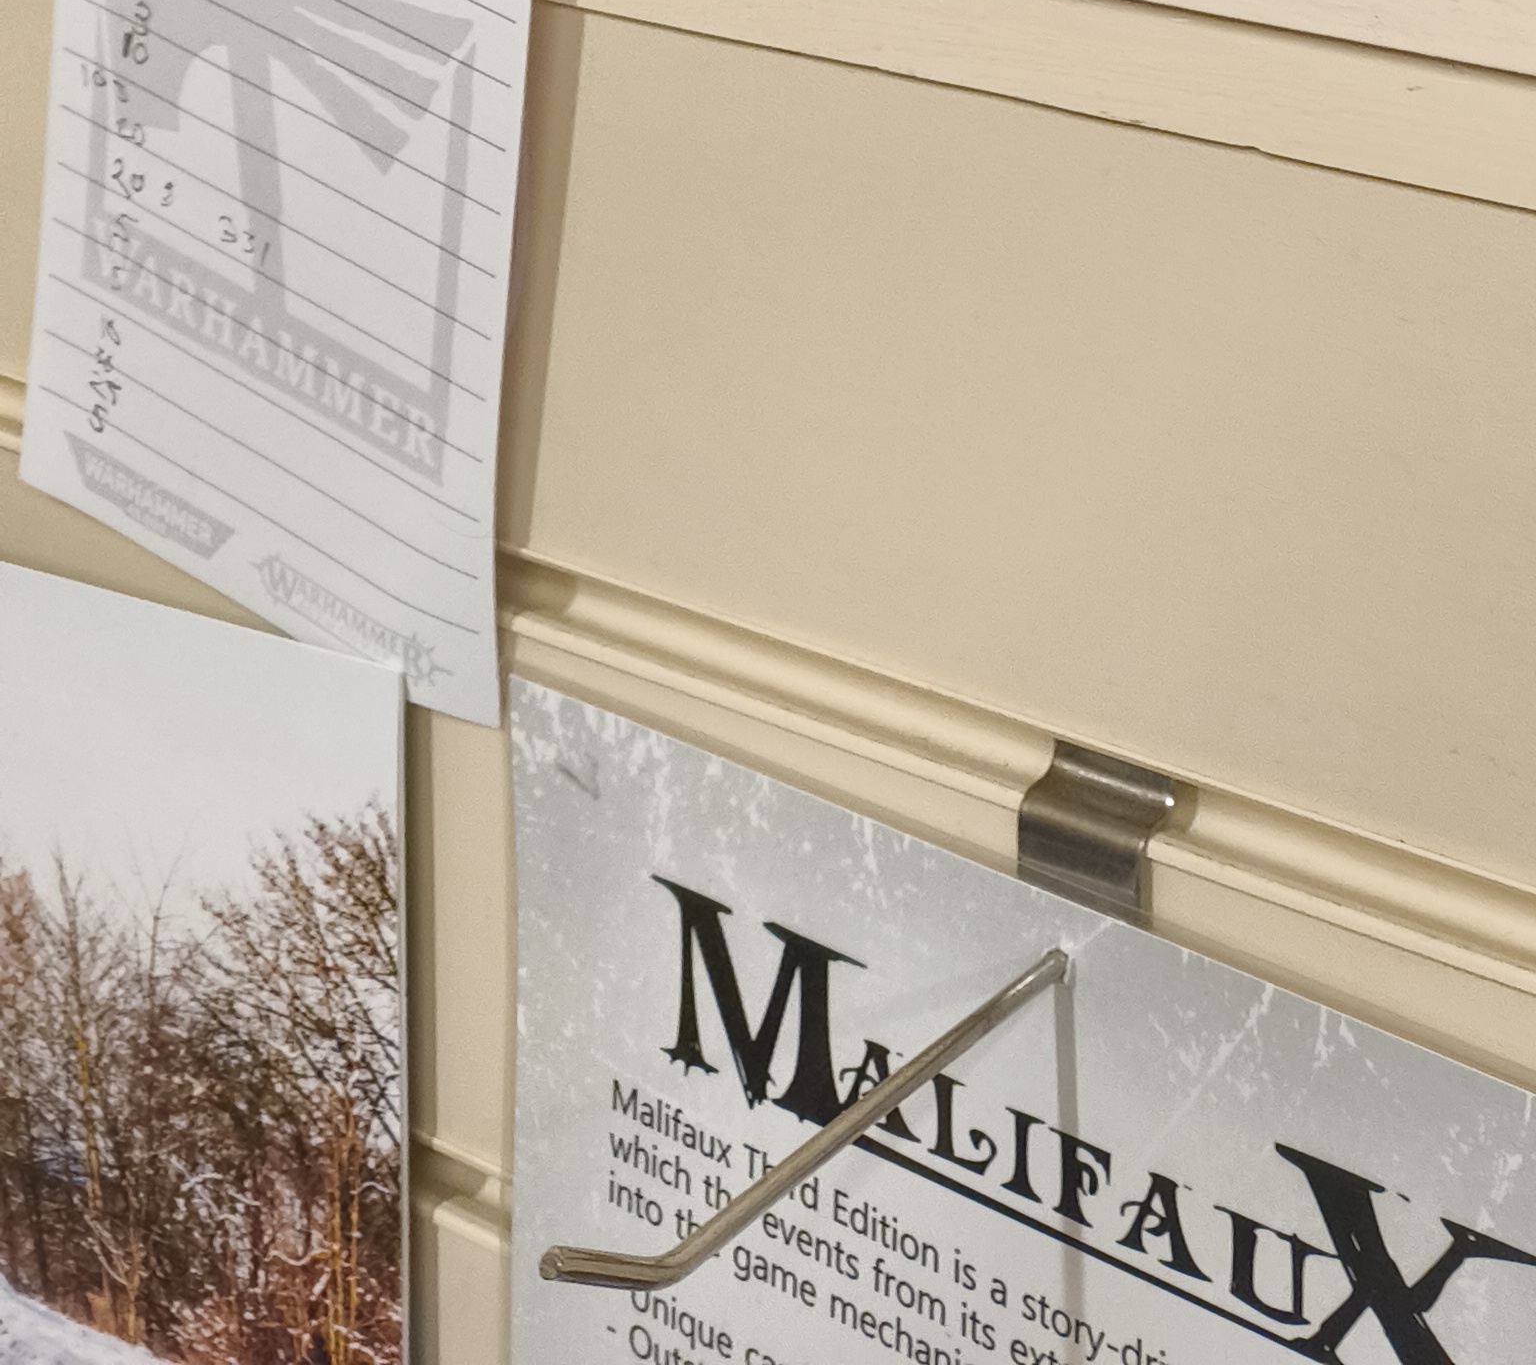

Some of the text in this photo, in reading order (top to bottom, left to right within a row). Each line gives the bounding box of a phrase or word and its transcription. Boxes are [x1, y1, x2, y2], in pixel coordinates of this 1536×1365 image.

[607, 1170, 664, 1226] into
[732, 1245, 817, 1307] game
[608, 1131, 692, 1195] which
[761, 1211, 860, 1281] events
[872, 1258, 946, 1326] from
[960, 1301, 996, 1351] its
[611, 1078, 733, 1169] Malifaux
[743, 1142, 819, 1212] Thd
[832, 1187, 940, 1273] Edition
[953, 1248, 977, 1291] is
[990, 1277, 1008, 1308] a
[628, 1324, 695, 1365] Out
[630, 1290, 734, 1359] Unique
